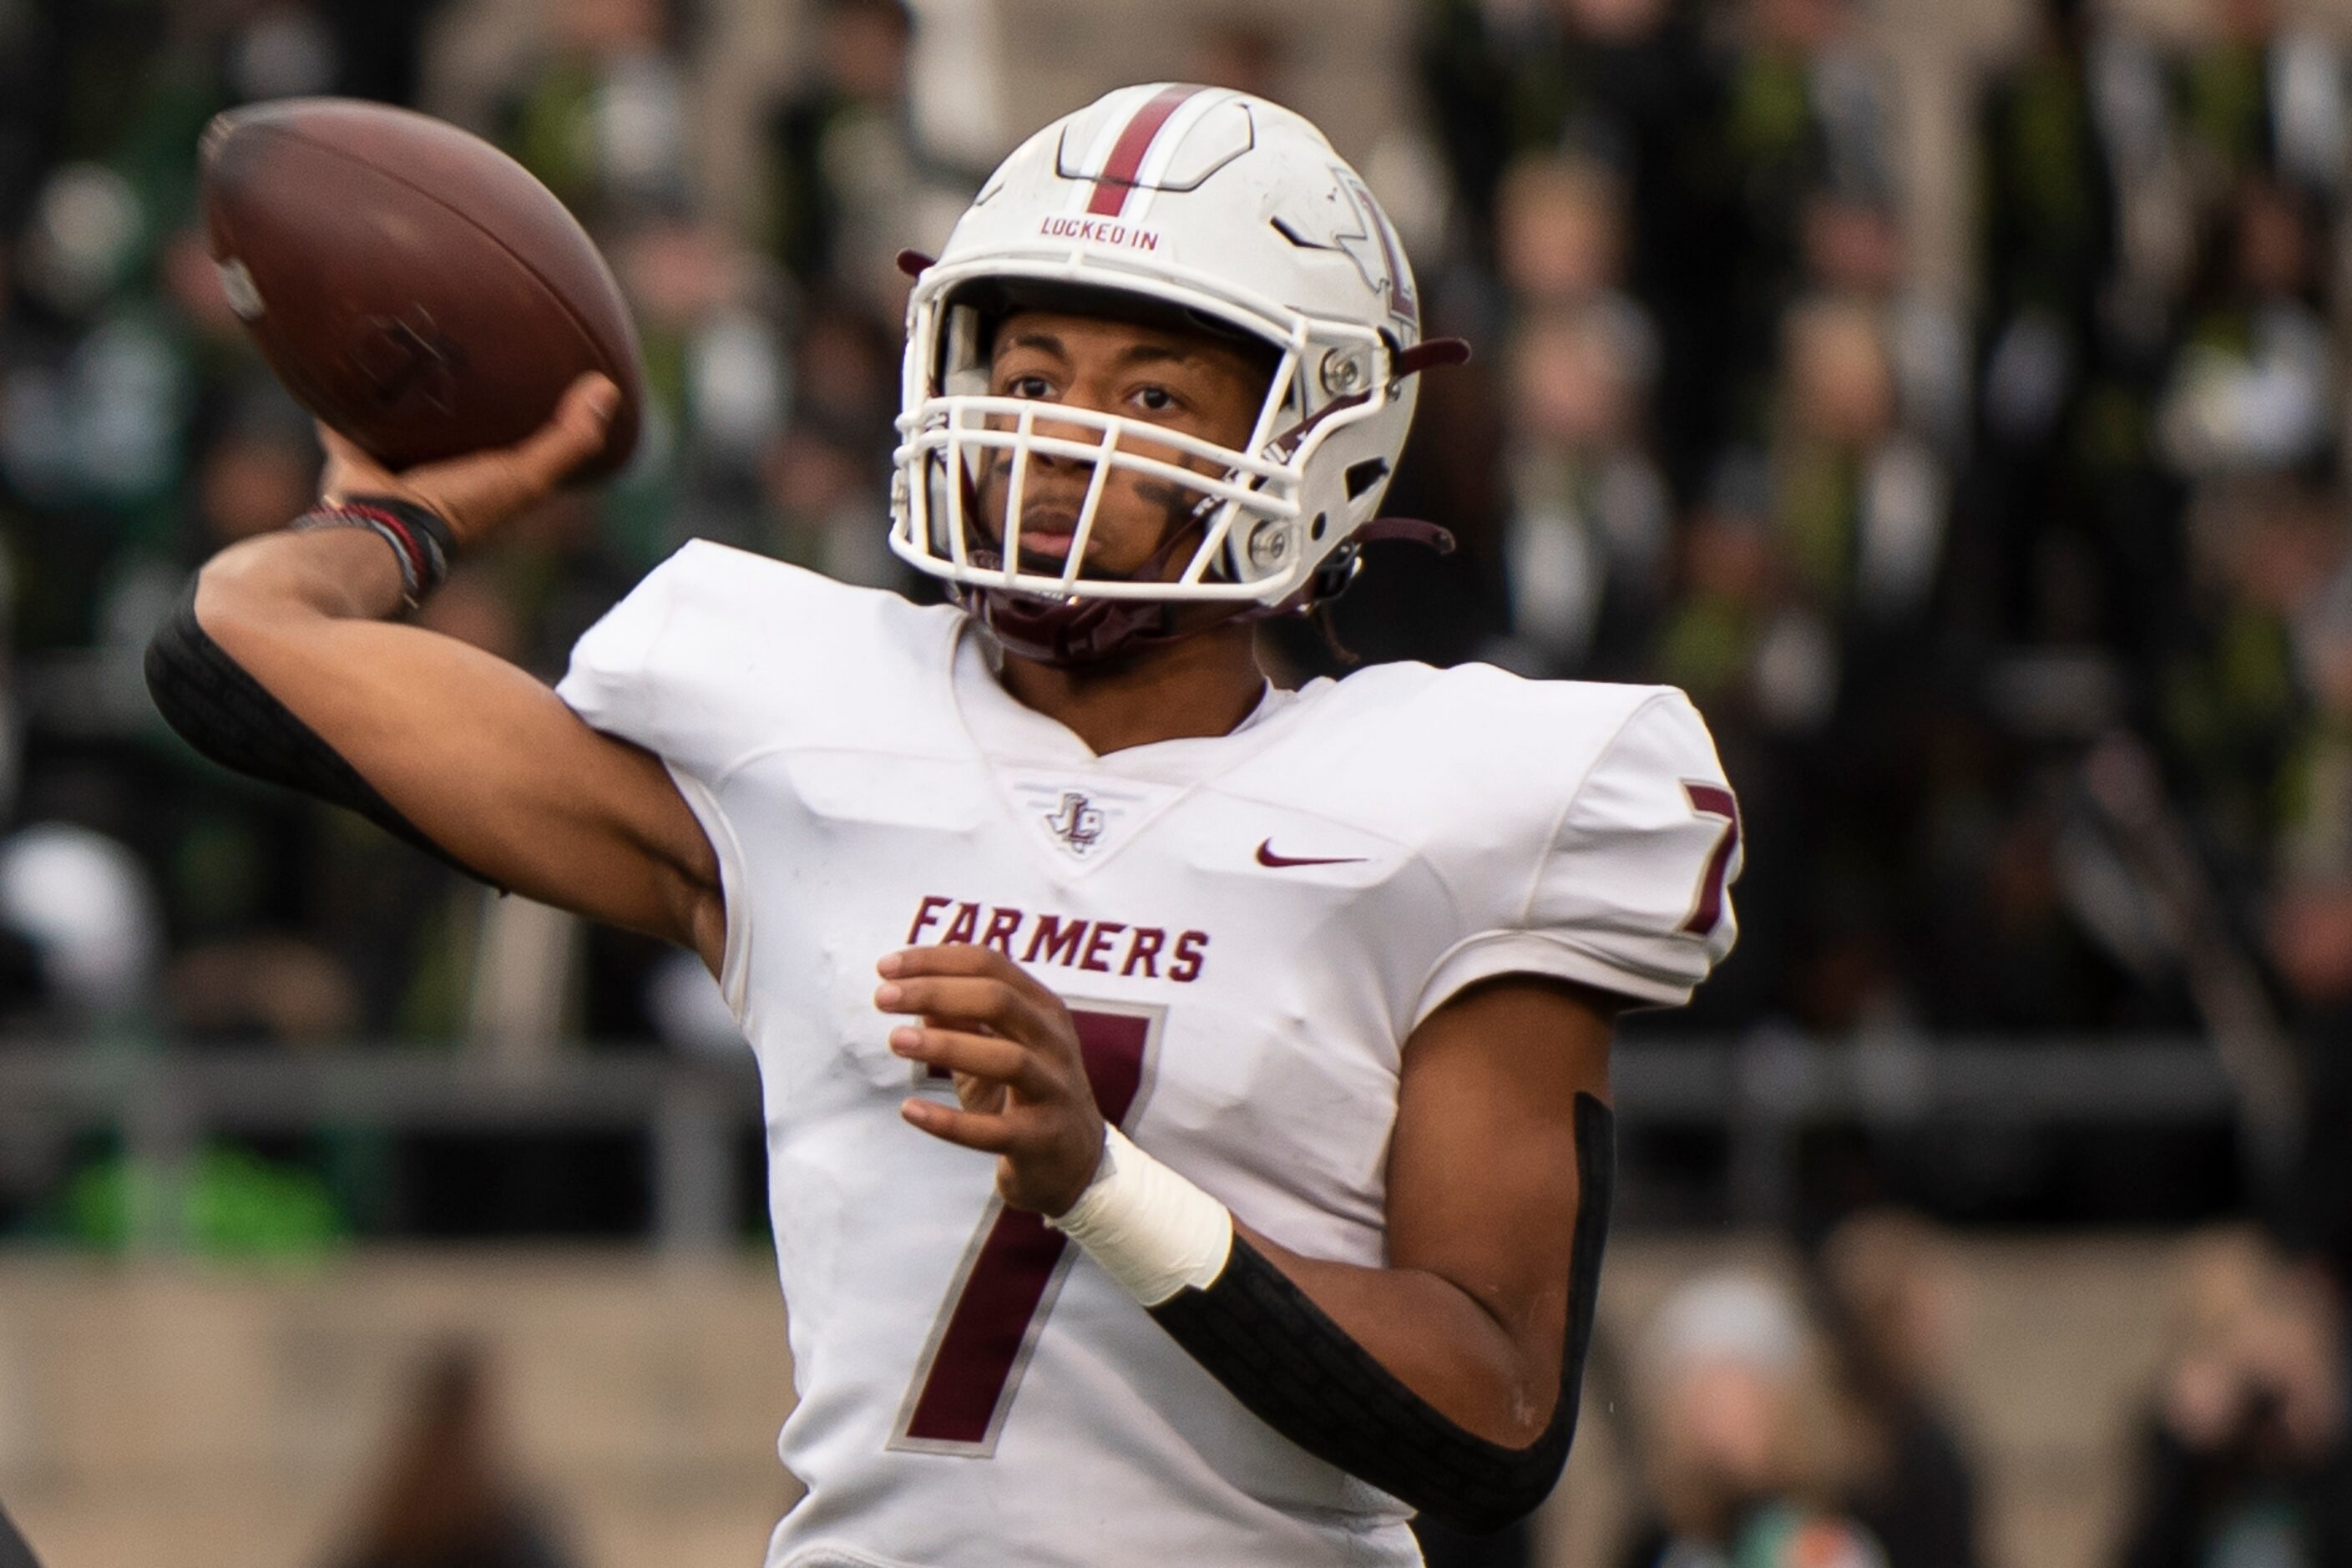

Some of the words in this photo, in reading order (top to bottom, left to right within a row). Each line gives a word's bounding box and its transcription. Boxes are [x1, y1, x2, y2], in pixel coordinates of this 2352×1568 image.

[1039, 215, 1126, 245] LOCKED
[1130, 230, 1159, 251] IN
[1673, 776, 1743, 941] 7
[906, 894, 1211, 983] FARMERS
[885, 995, 1168, 1459] 7
